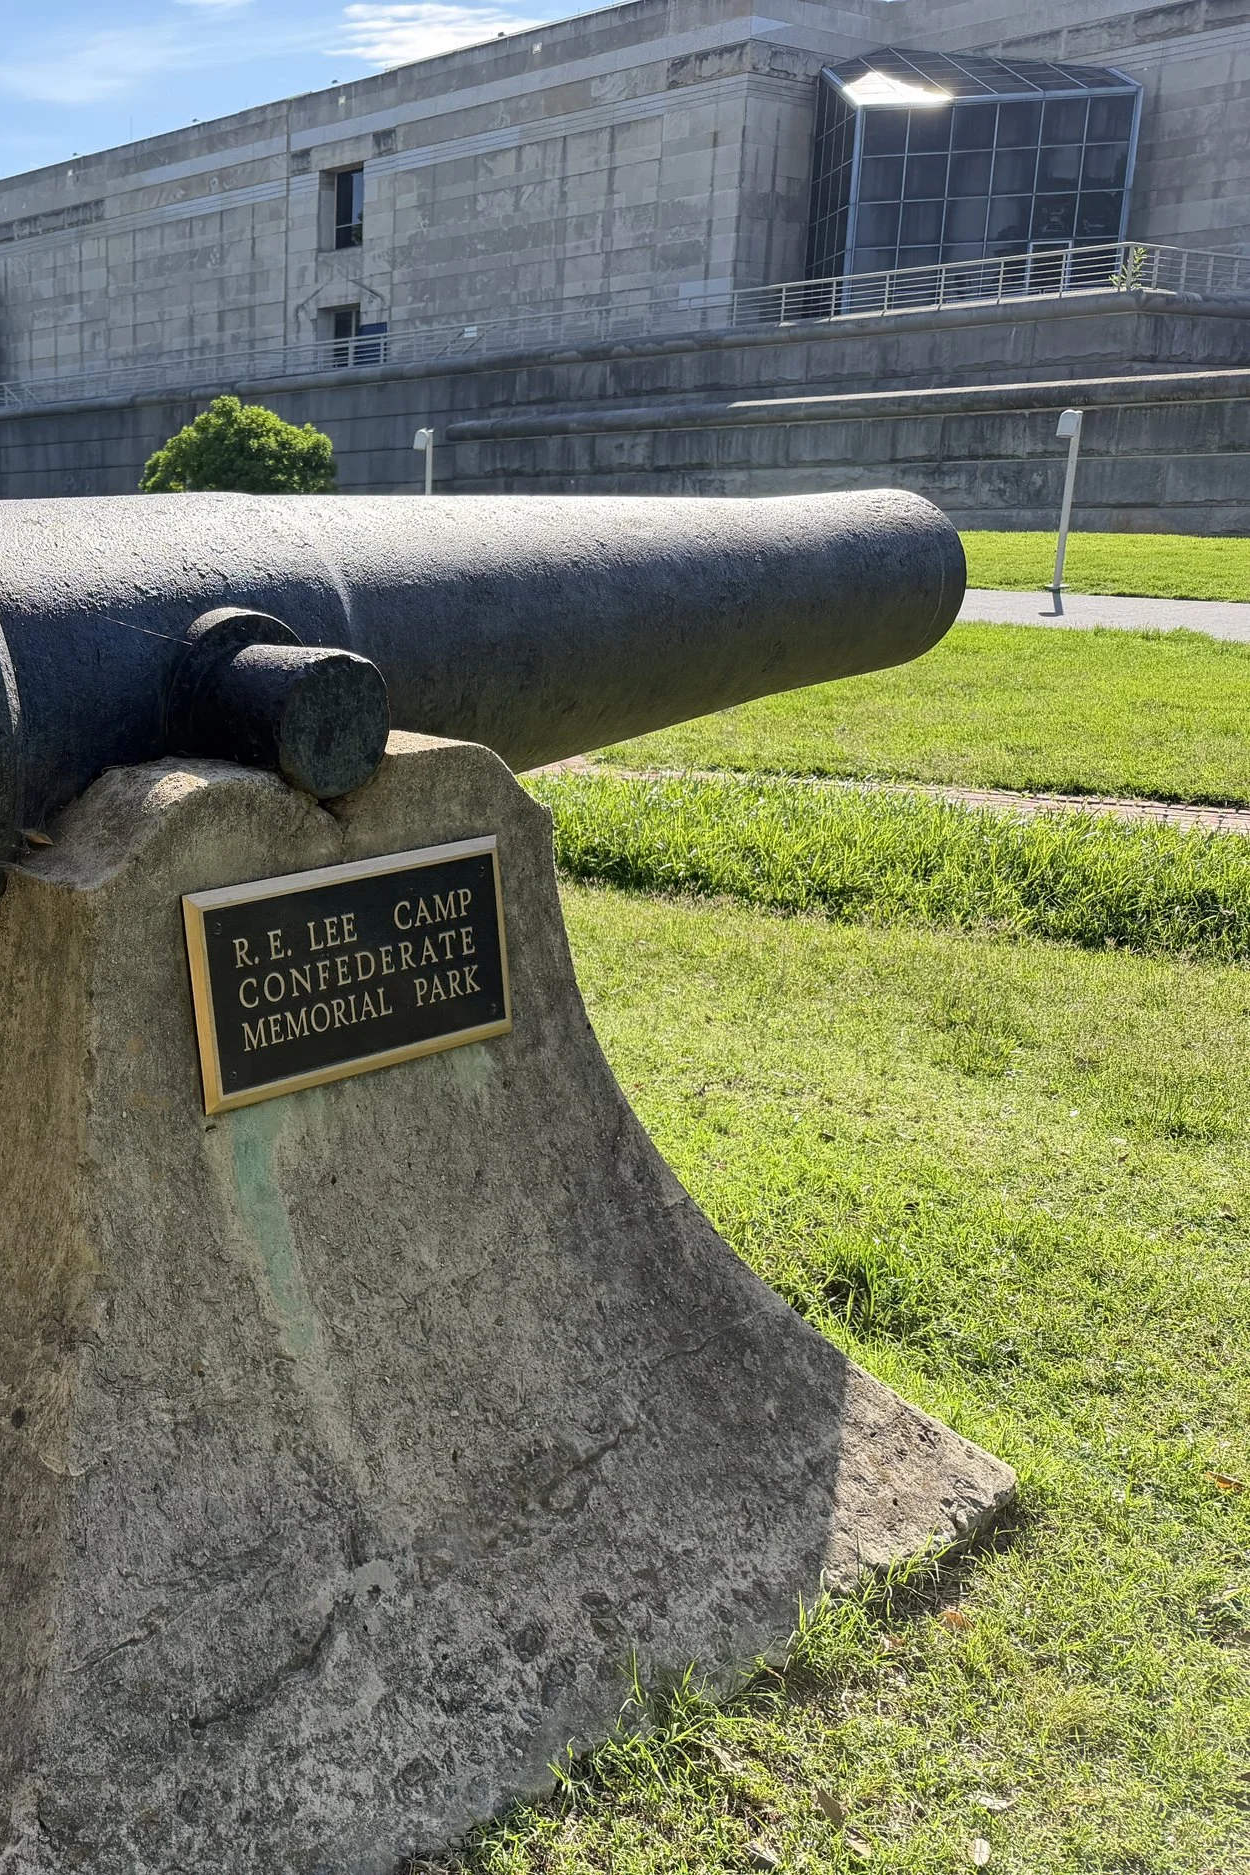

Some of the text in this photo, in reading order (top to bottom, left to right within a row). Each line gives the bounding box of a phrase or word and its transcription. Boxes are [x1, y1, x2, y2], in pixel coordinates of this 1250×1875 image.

[233, 887, 473, 968] R. E. LEE CAMP
[238, 926, 477, 1009] CONFEDERATE
[241, 965, 482, 1051] MEMORIAL PARK
